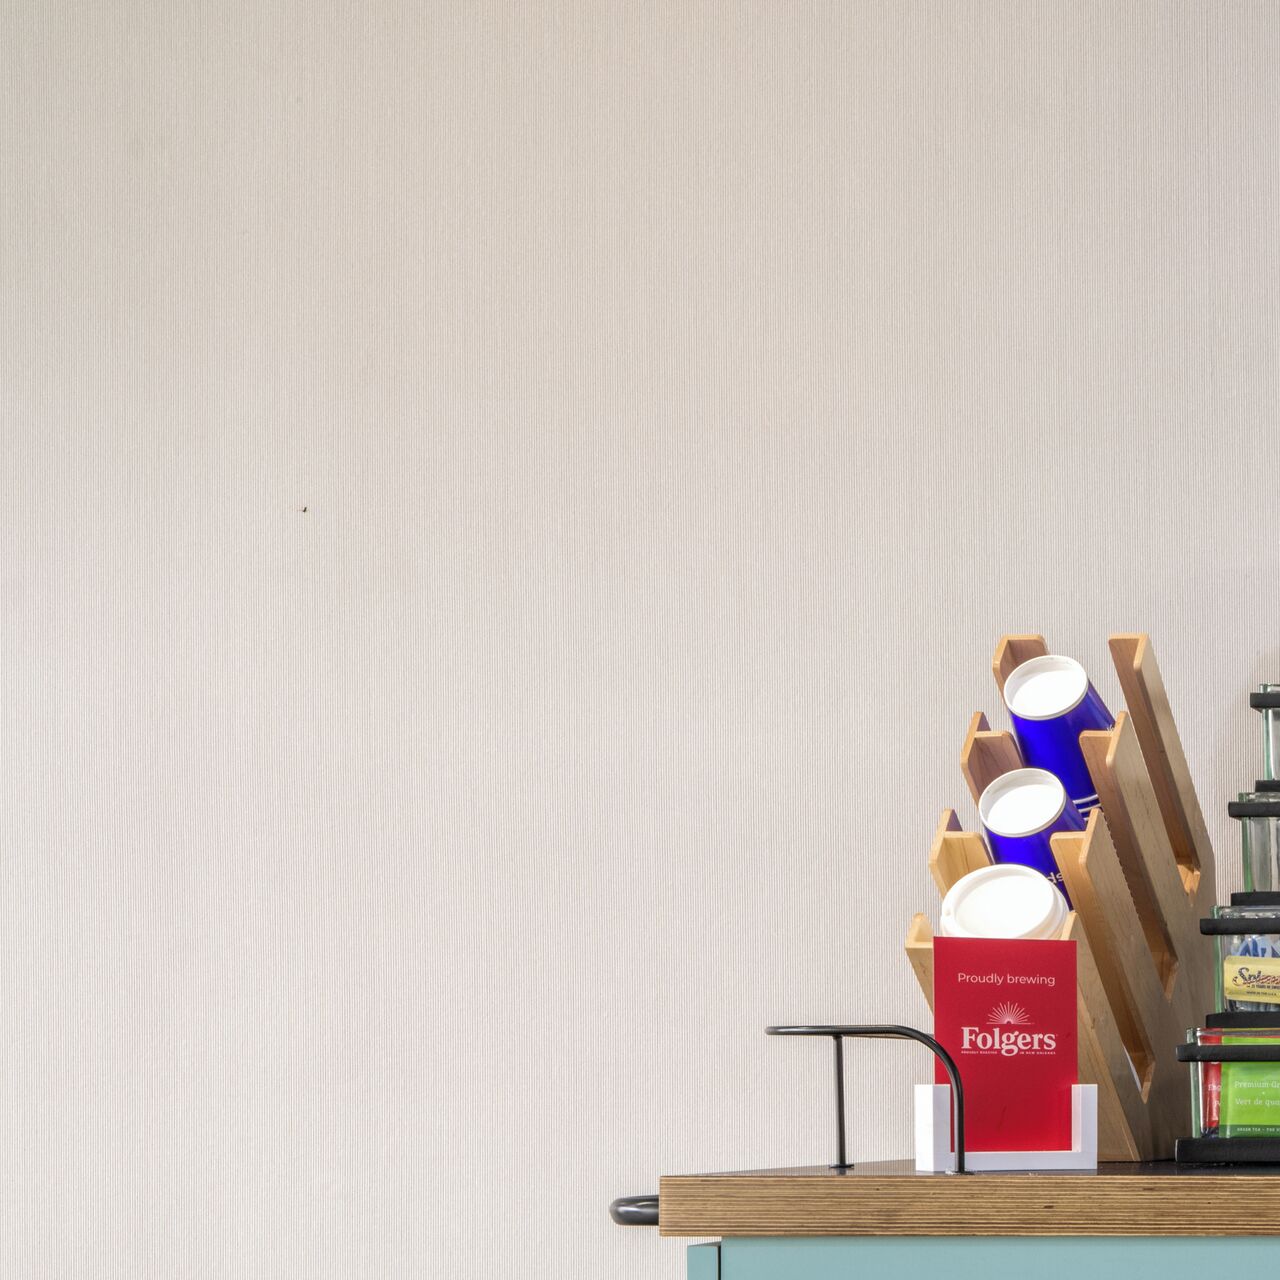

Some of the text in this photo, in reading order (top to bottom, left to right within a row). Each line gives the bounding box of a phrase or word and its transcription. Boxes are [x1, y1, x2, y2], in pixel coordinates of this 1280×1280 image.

[958, 972, 1056, 987] Proudly brewing
[961, 1026, 1056, 1056] Folgers
[1234, 1080, 1268, 1088] Premium
